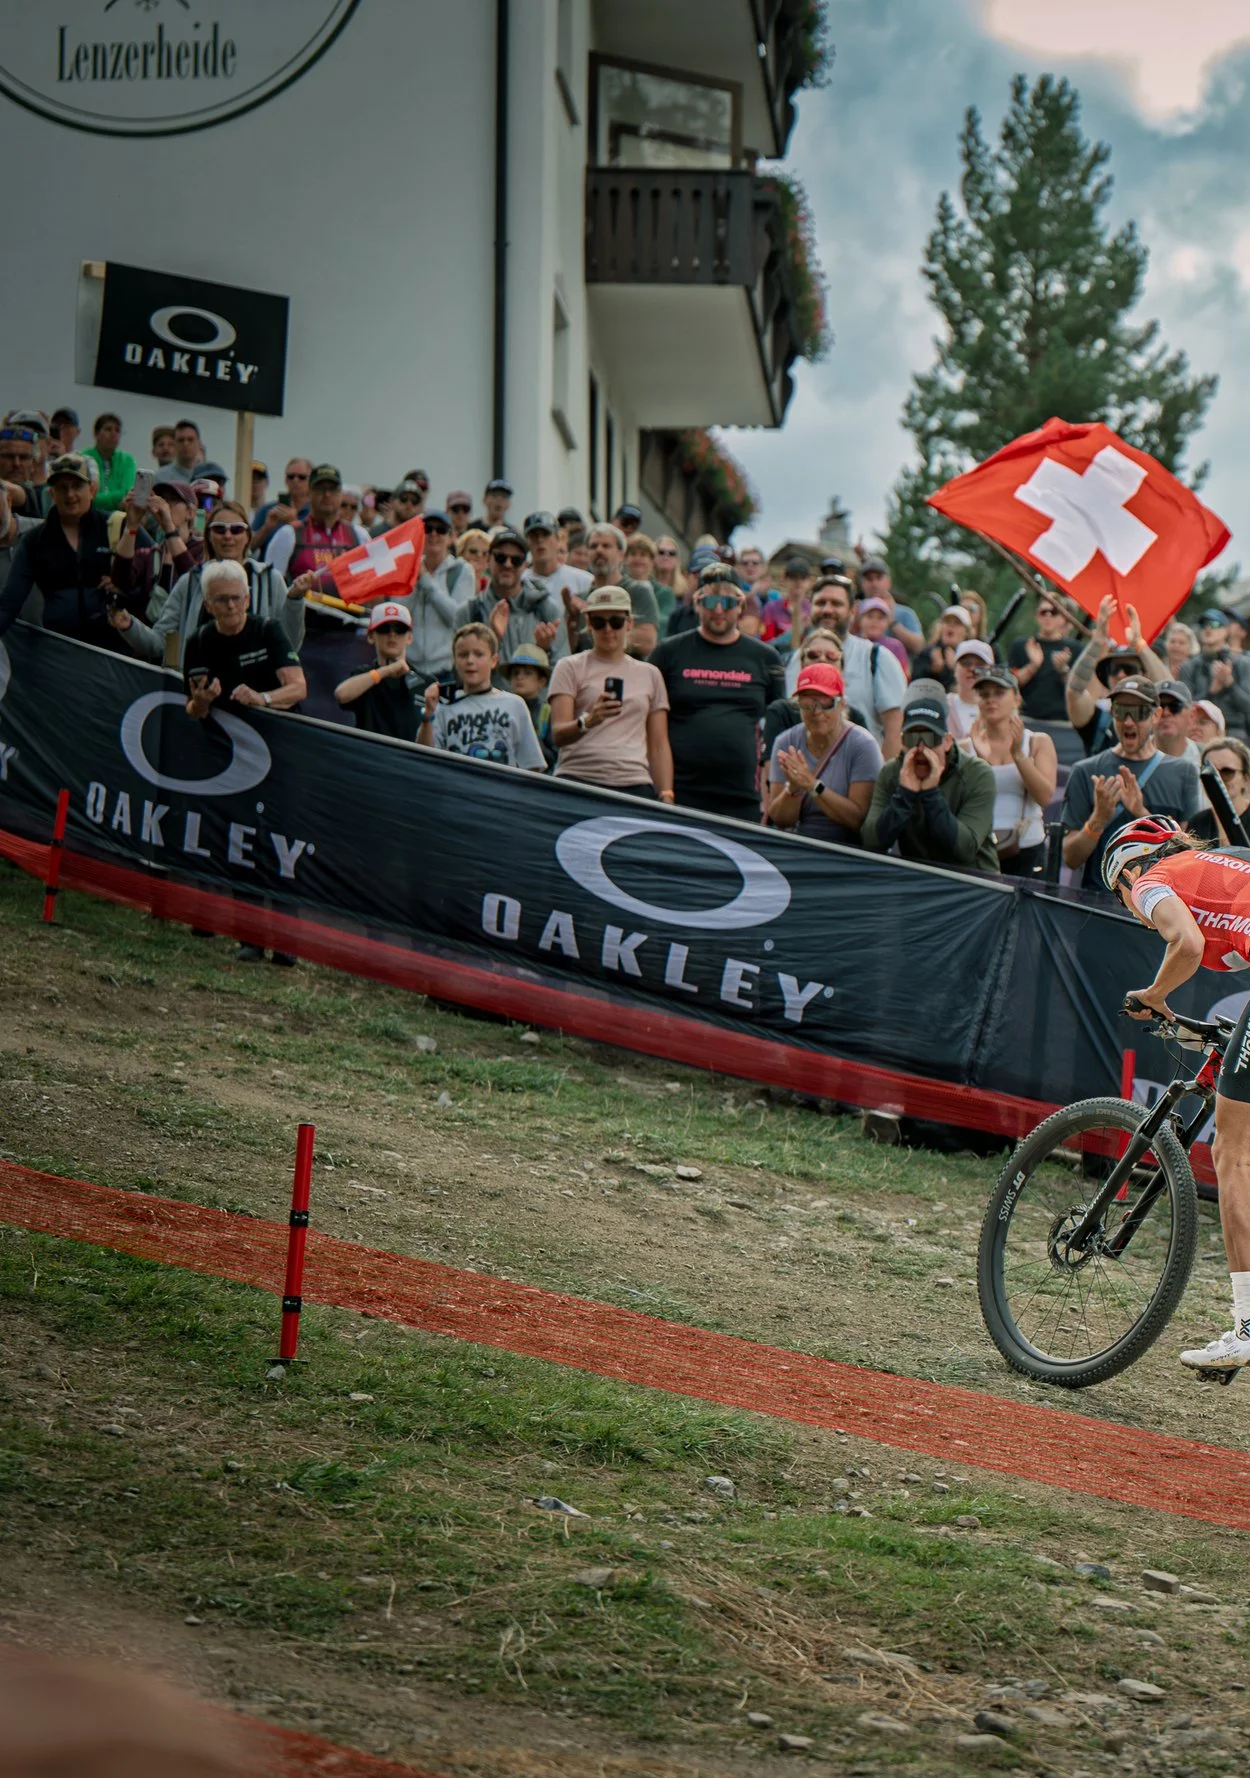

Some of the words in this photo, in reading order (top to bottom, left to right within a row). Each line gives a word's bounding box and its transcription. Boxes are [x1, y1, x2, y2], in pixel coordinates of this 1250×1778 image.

[57, 22, 237, 82] Lenzerheide
[124, 343, 254, 385] OAKLEY
[1013, 1170, 1026, 1190] DT
[999, 1189, 1016, 1222] SWISS
